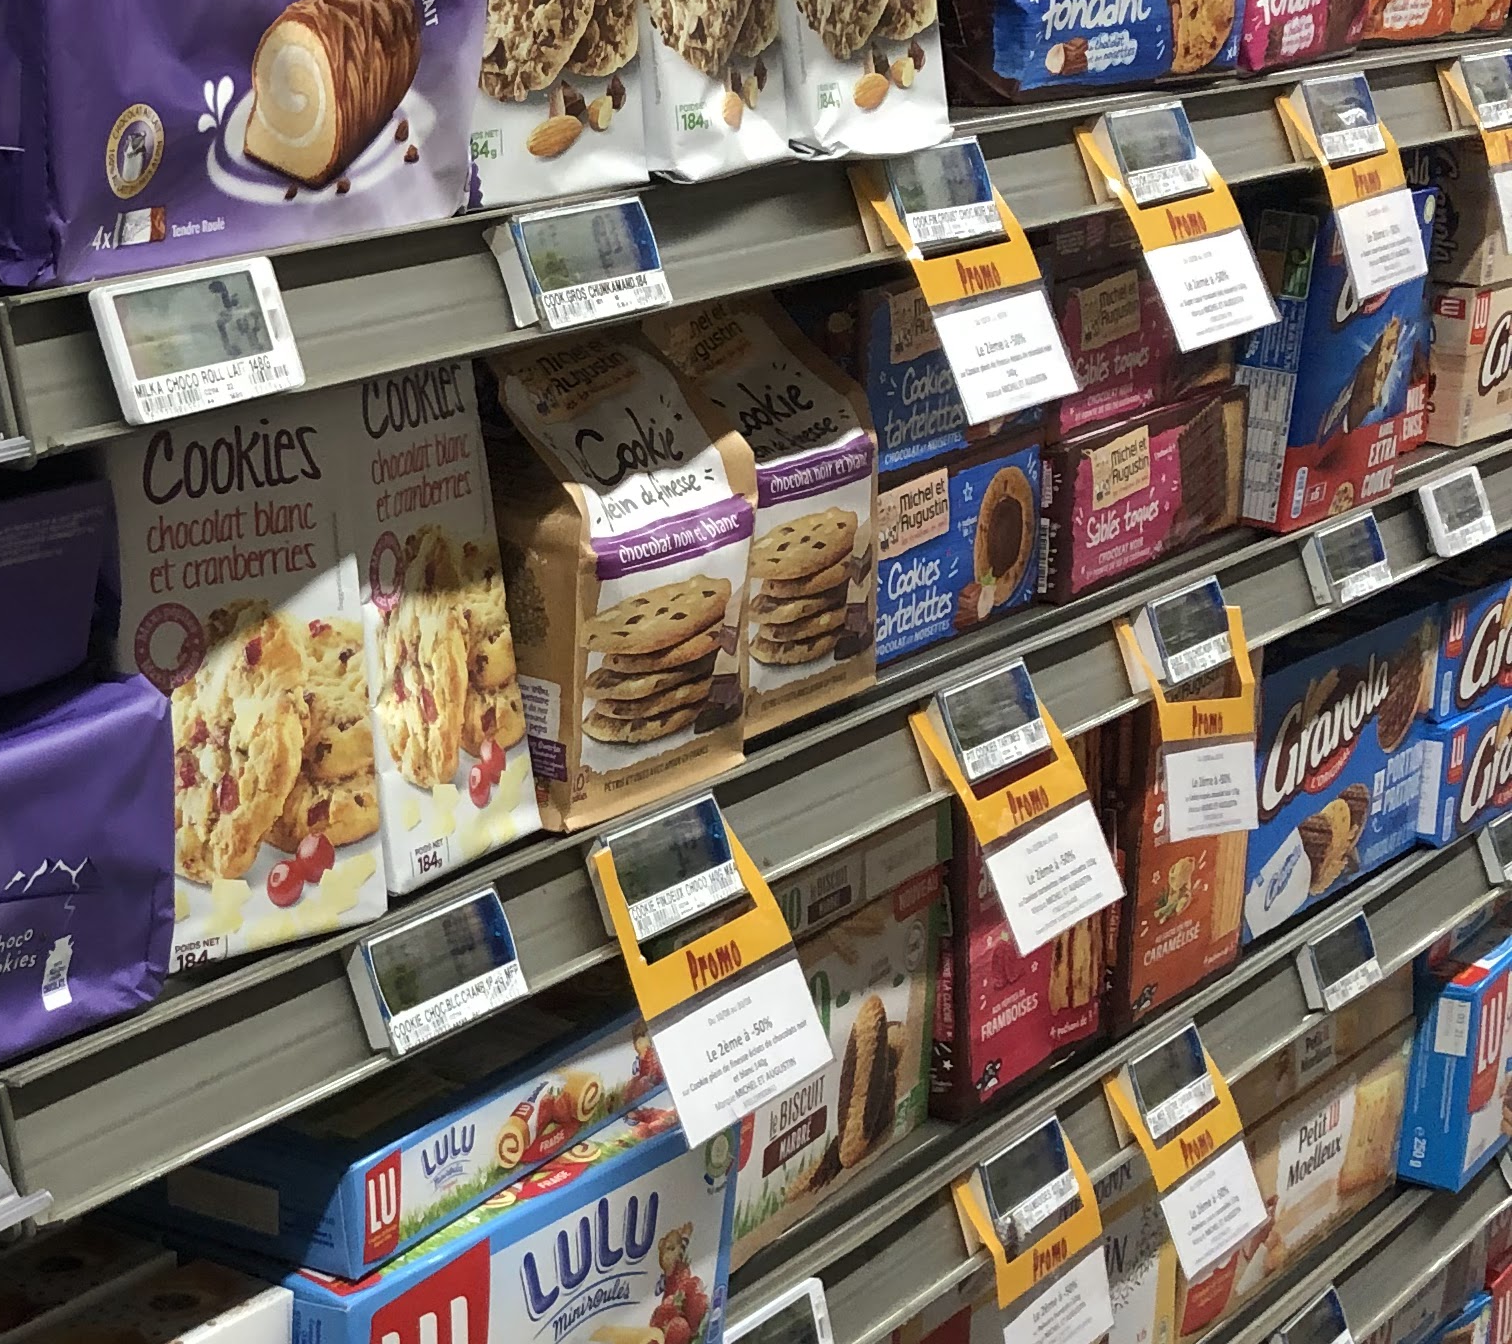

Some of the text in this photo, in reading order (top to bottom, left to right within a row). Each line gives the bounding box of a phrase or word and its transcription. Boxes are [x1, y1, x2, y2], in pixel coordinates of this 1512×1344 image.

[91, 225, 112, 251] 4x
[955, 257, 1002, 295] Promo
[134, 367, 226, 398] MILKA CHOCO ROLL
[361, 361, 465, 440] Cookies
[142, 418, 323, 506] Cookies
[575, 406, 684, 488] Cookie
[1111, 455, 1150, 486] Augustin
[770, 469, 812, 493] chocolat
[899, 483, 934, 511] Michel
[146, 506, 251, 555] chocolat
[254, 499, 318, 535] blanc
[619, 512, 741, 565] chocolat blanc
[900, 497, 949, 534] Augustin
[149, 541, 318, 594] et cranberries
[888, 556, 942, 601] Cookies
[1261, 651, 1391, 813] Granola
[1007, 784, 1049, 825] Promo
[686, 939, 743, 992] Promo
[1142, 921, 1202, 967] CARAMÉLISÉ
[393, 1013, 424, 1039] COOKIE
[980, 992, 1040, 1042] FRAMBOISES
[705, 1034, 743, 1064] Le 2ème
[778, 1074, 827, 1133] BISCUIT
[420, 1122, 476, 1176] LULU
[538, 1127, 567, 1154] FRAISE
[1298, 1115, 1327, 1153] Petit
[1286, 1133, 1344, 1191] Moelleux
[367, 1165, 398, 1233] LU
[520, 1191, 659, 1323] LULU
